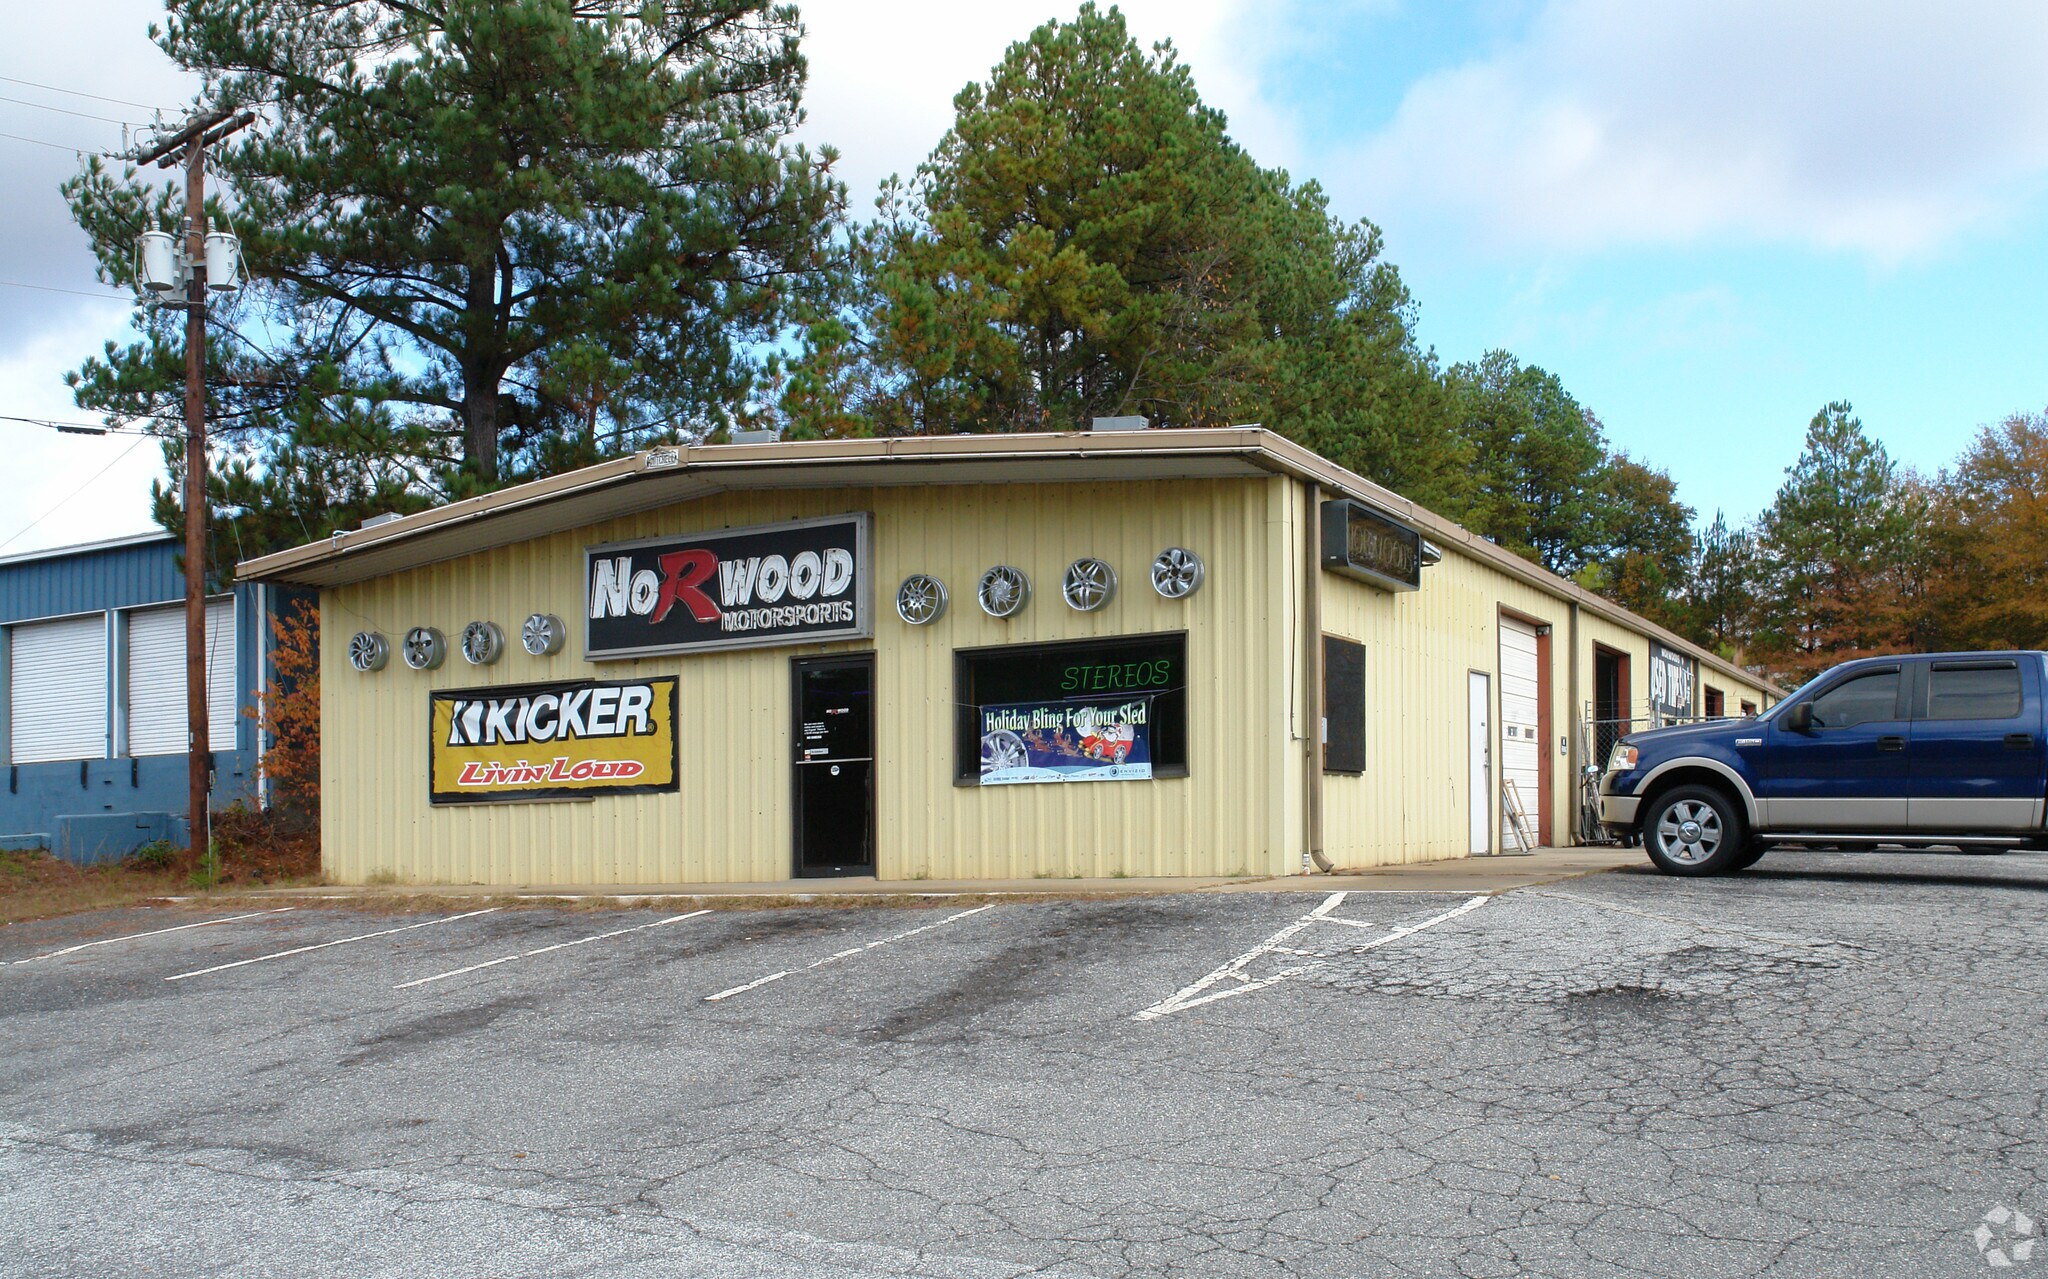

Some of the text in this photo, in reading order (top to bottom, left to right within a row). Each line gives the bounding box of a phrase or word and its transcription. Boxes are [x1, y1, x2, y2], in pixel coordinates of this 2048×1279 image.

[721, 601, 853, 632] MOTORSPORTS
[1061, 660, 1170, 690] STEREOS
[985, 702, 1147, 735] Holiday Bling For Your Sled
